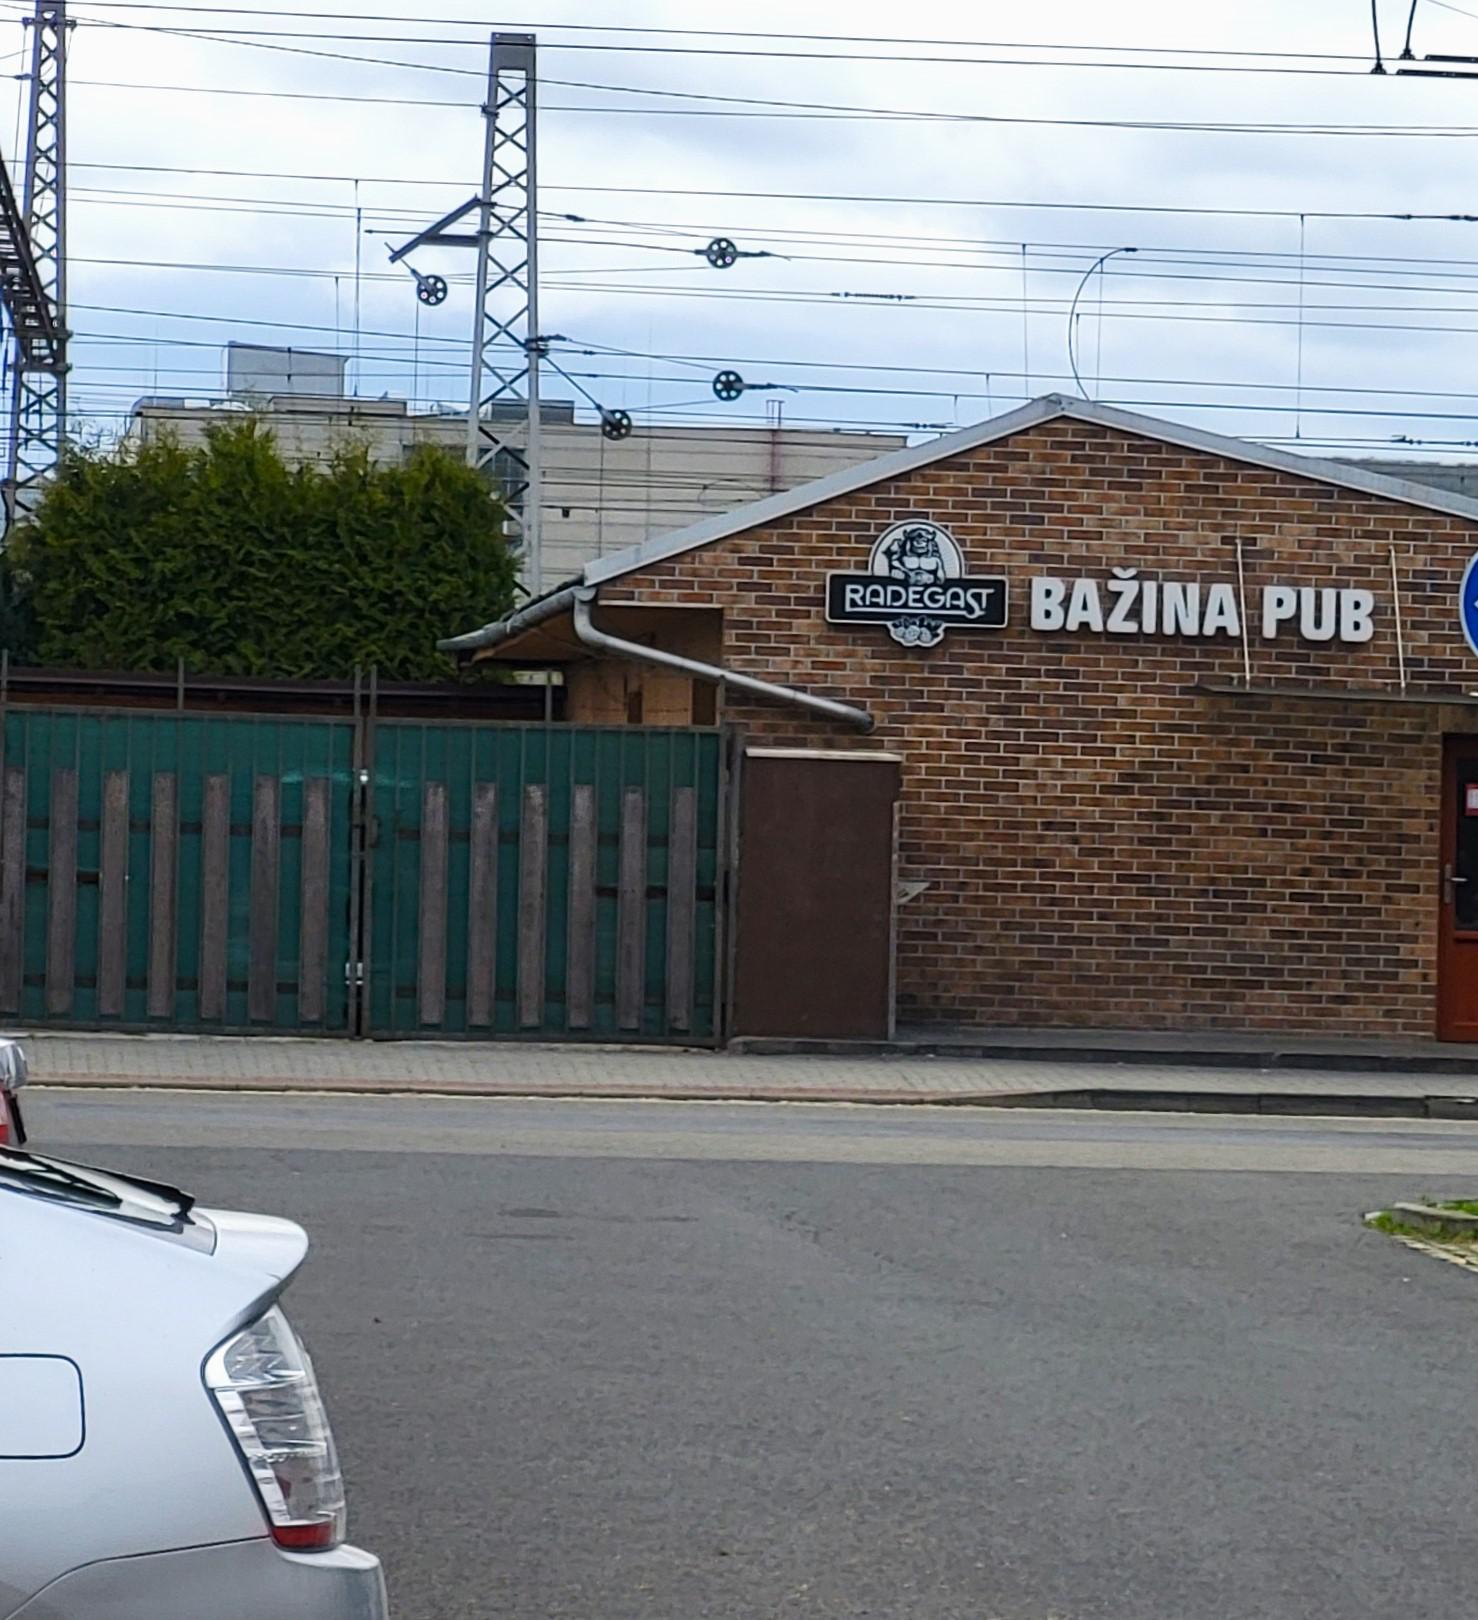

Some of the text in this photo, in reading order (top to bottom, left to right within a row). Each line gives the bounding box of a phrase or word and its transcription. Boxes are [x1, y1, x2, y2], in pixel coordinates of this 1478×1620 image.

[845, 584, 995, 619] RADEGAST
[1030, 567, 1374, 643] BAŽINA PUB
